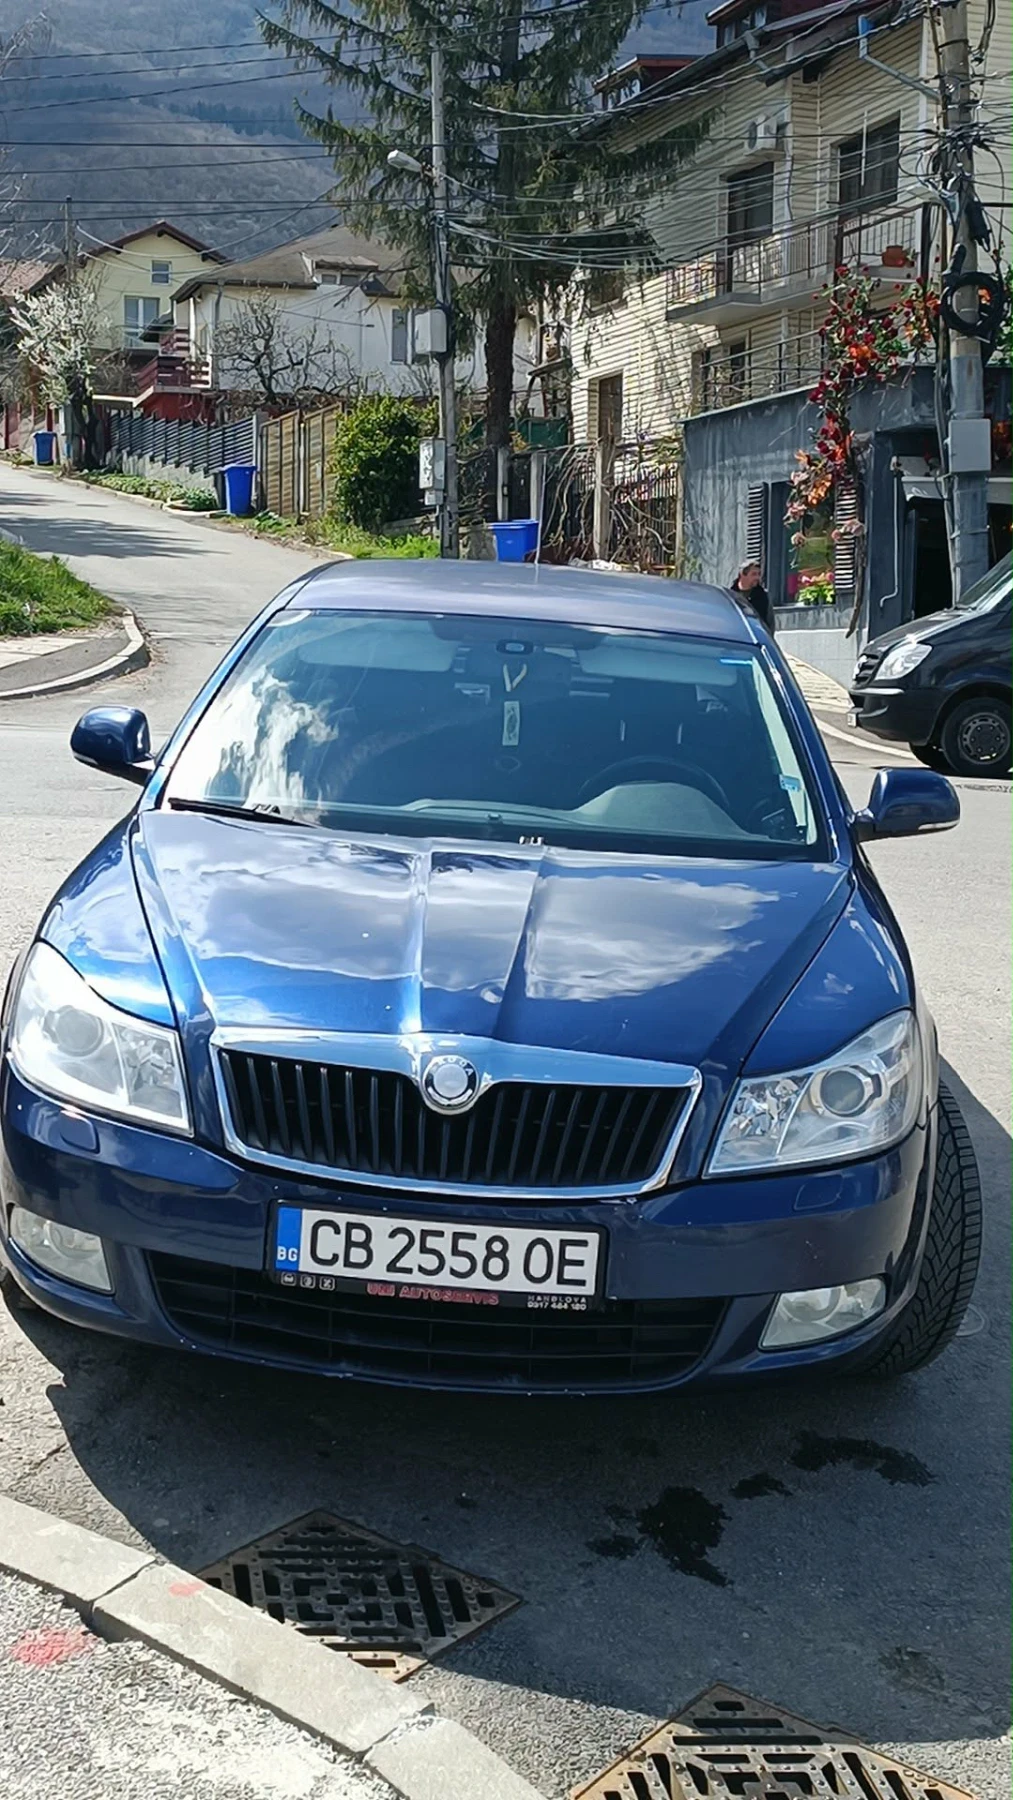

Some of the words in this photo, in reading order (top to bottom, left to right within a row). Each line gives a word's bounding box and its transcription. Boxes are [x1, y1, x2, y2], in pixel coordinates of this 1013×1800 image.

[277, 1245, 299, 1262] BG
[310, 1218, 374, 1270] CB
[385, 1226, 510, 1282] 2558
[523, 1237, 589, 1287] OE
[399, 1285, 499, 1305] AUTOSERVIS
